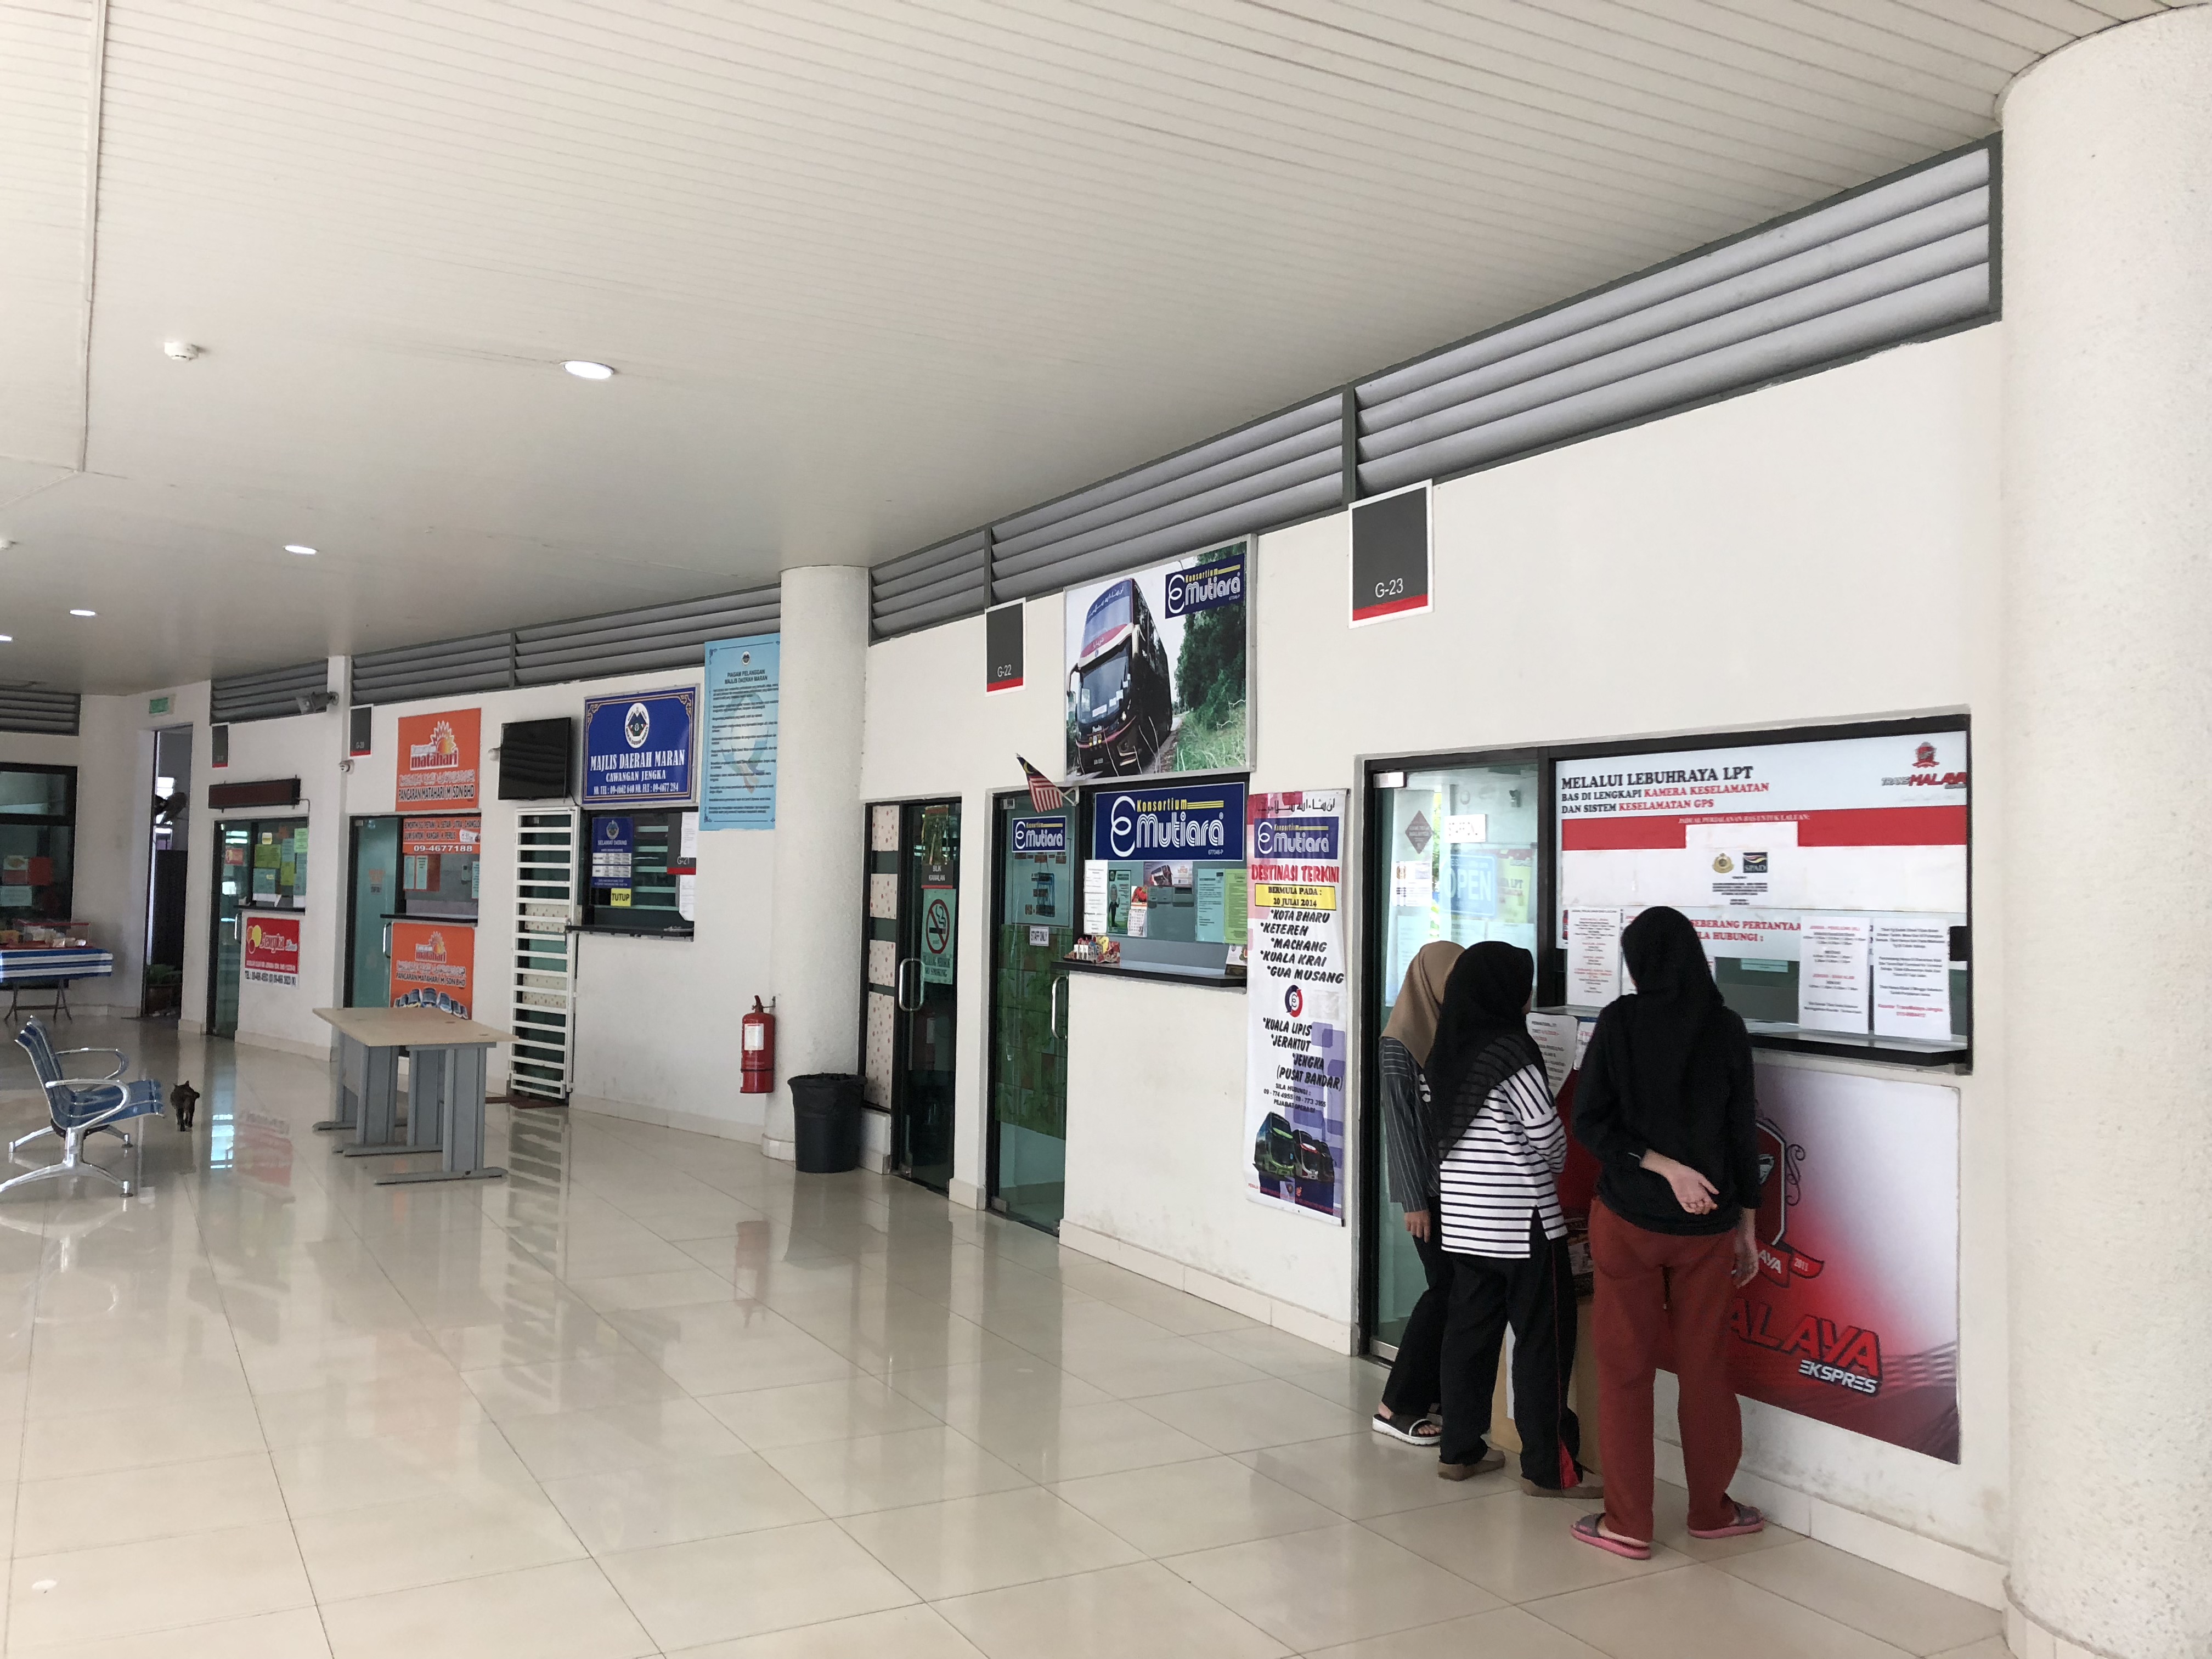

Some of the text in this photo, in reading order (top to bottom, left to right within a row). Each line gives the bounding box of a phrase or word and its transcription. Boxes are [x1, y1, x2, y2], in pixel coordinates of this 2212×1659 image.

[1186, 568, 1218, 583] Konsortium
[1375, 578, 1403, 597] G-23
[997, 664, 1012, 677] G-22
[411, 750, 457, 768] matahari
[590, 749, 685, 772] MAJLIS DAERAH MARAN
[606, 770, 666, 782] CAWANGAN JENGKA
[1561, 766, 1754, 789] MELALUI LEBUHRAYA LPT
[422, 786, 444, 799] MATAHARI
[453, 785, 463, 798] SDN
[464, 785, 474, 797] BHD
[1561, 782, 1769, 802] BAS DI LENGKAPI KAMERA KESELAMATAN
[1137, 798, 1187, 812] Konsortium
[1561, 799, 1714, 814] DAN SISTEM KESELAMATAN GPS
[677, 856, 690, 865] G-21
[1251, 864, 1339, 883] DESTINASI TERKINI
[1268, 886, 1297, 895] BERMULA
[1299, 887, 1319, 895] PADA
[1442, 868, 1492, 901] OPEN
[1281, 898, 1299, 907] JULAI
[1300, 899, 1317, 907] 2014
[1272, 909, 1330, 923] KOTA BHARU
[1031, 930, 1040, 941] STAFF
[1713, 932, 1758, 941] HUBUNGI
[1262, 950, 1327, 967] KUALA KRAI
[1269, 966, 1344, 984] GUA MUSANG
[1264, 1018, 1312, 1036] KUALA LIPIS
[1294, 1054, 1324, 1070] JENGKA
[1277, 1065, 1344, 1092] (PUSAT BANDAR)
[1287, 1086, 1308, 1095] HUBUNGI
[1274, 1099, 1294, 1109] PEJABAT
[1731, 1296, 1882, 1378] ALAYA
[1798, 1359, 1878, 1394] EKSPRES
